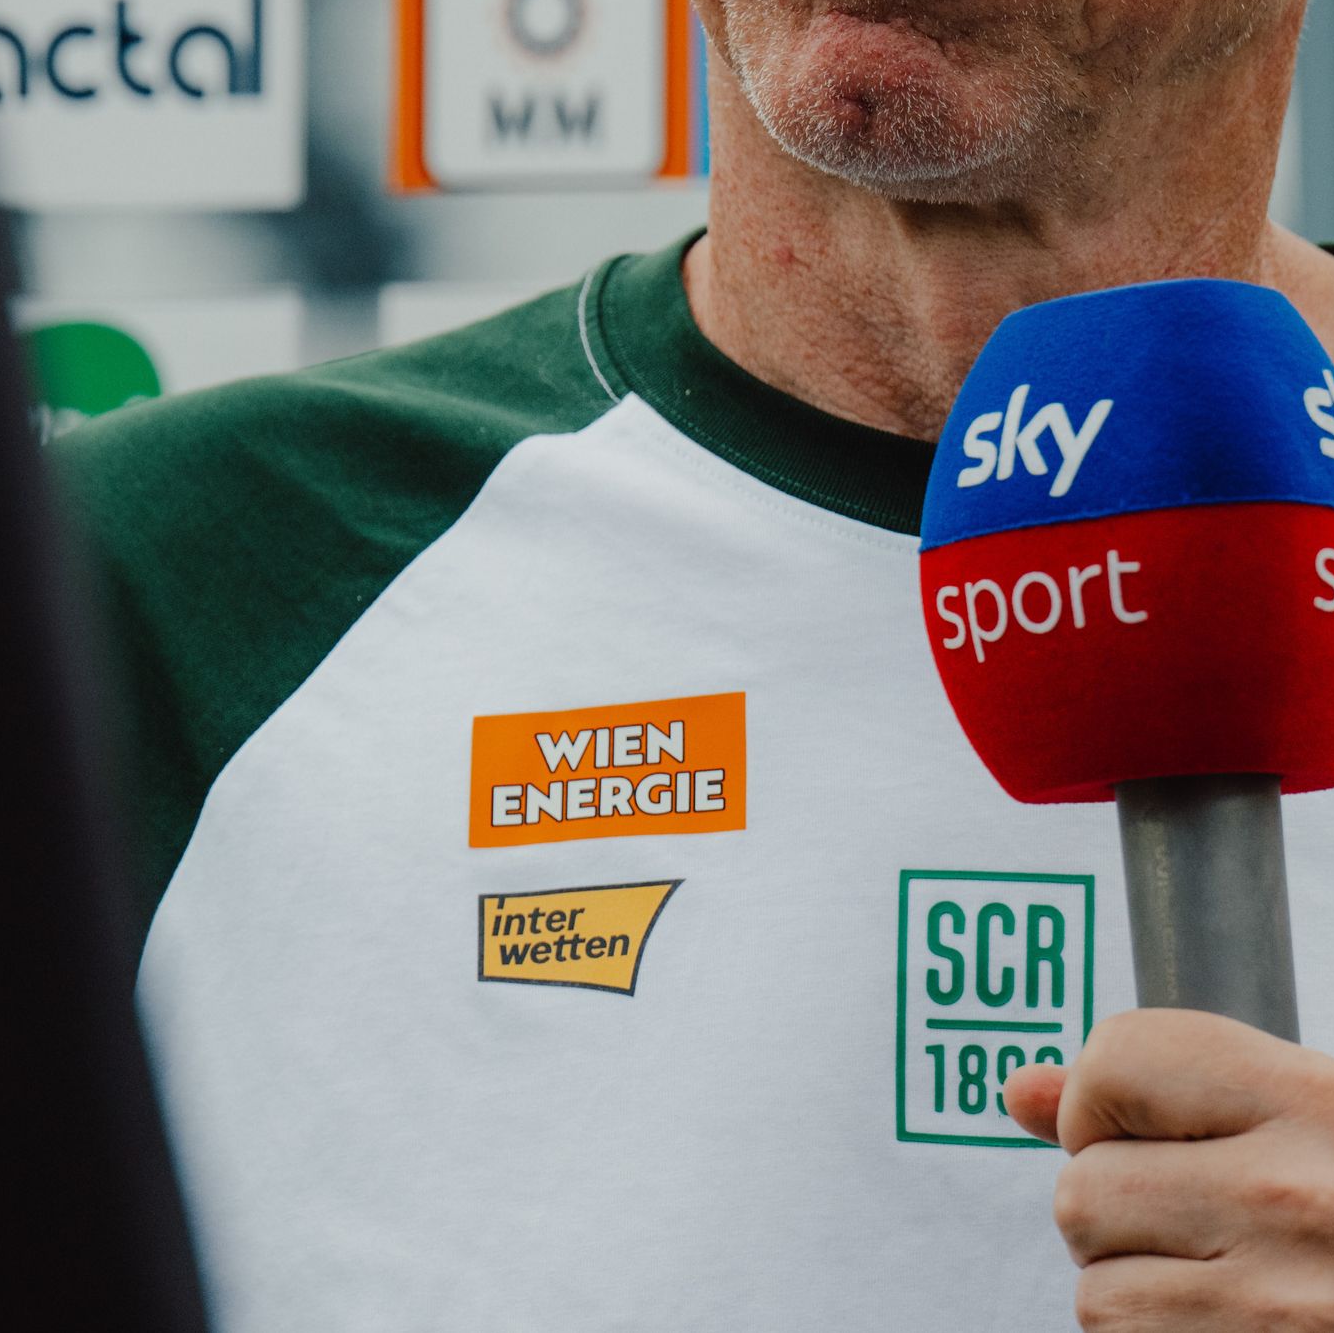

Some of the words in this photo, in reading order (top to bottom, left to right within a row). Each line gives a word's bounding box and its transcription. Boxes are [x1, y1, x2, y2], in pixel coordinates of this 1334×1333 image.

[956, 384, 1114, 497] sky
[935, 549, 1149, 663] sport
[535, 720, 685, 774] WIEN
[491, 768, 726, 827] ENERGIE
[492, 896, 586, 936] inter
[499, 933, 630, 966] wetten
[925, 900, 1066, 1008] SCR
